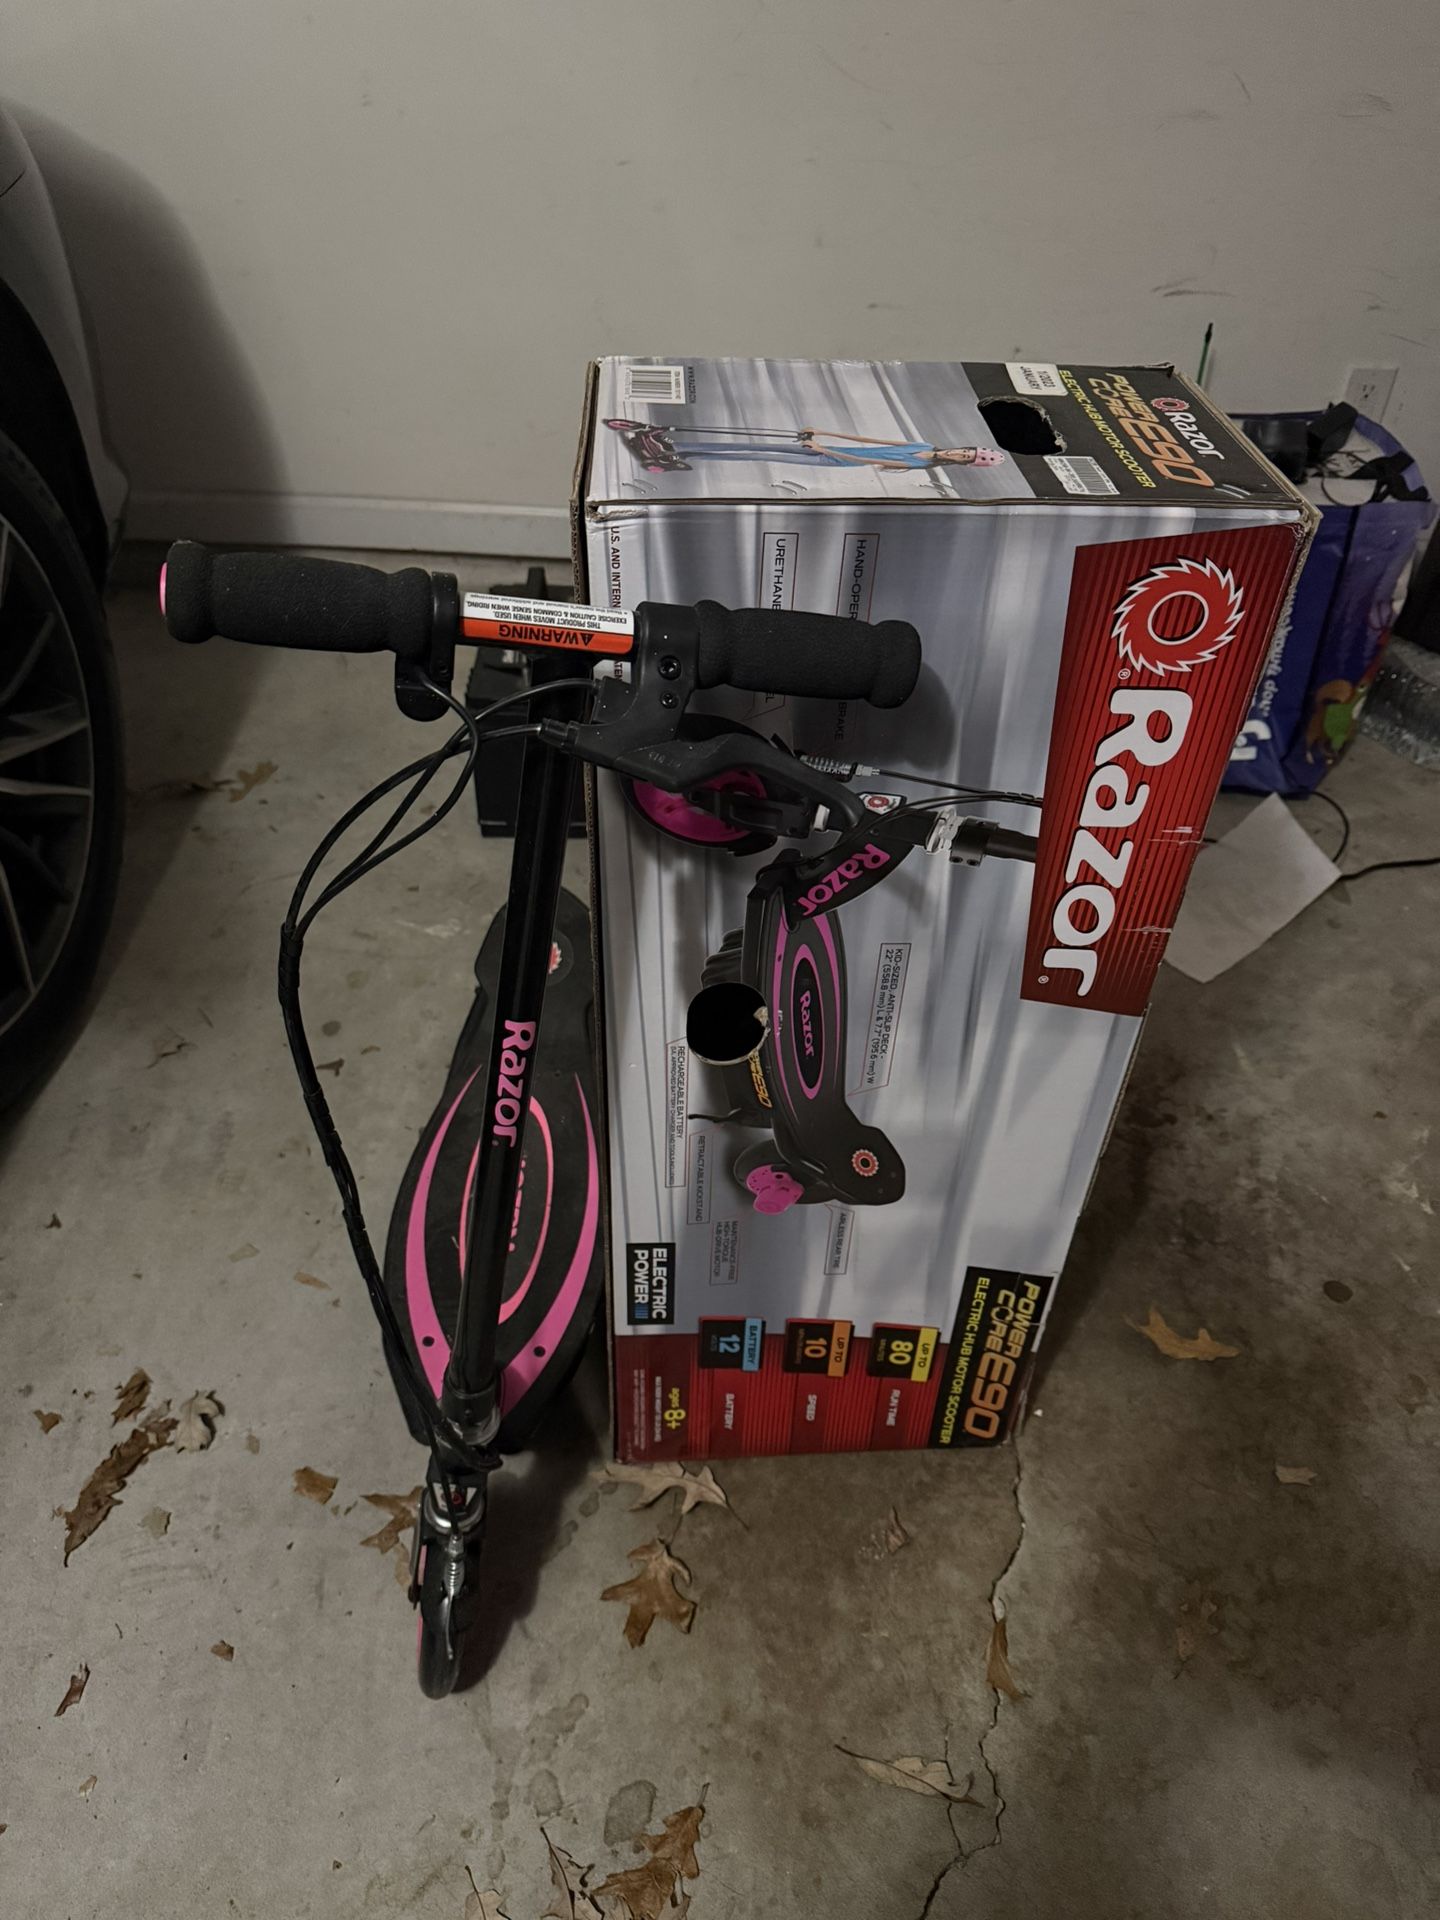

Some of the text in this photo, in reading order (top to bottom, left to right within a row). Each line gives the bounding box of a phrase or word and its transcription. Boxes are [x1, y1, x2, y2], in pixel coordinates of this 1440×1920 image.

[1020, 365, 1042, 390] JANUARY
[1088, 378, 1133, 418] CORE
[1105, 373, 1159, 422] POWER
[1059, 370, 1091, 403] ELECTRIC
[1081, 403, 1103, 419] HUB
[1093, 420, 1124, 448] MOTOR
[1115, 449, 1156, 488] SCOOTER
[1165, 412, 1224, 460] Razor
[1119, 418, 1214, 487] E90
[610, 526, 620, 544] U.S.
[612, 547, 620, 569] AND
[772, 538, 786, 610] URETHANE
[466, 601, 490, 610] RIDING.
[491, 603, 510, 612] WHEN
[493, 611, 511, 619] USED.
[512, 606, 532, 614] SENSE
[513, 613, 532, 622] WHEN
[533, 608, 562, 617] COMMON
[533, 615, 555, 624] MOVES
[557, 617, 586, 628] PRODUCT
[570, 611, 596, 621] CAUTION
[598, 615, 627, 623] EXERCISE
[499, 625, 578, 645] WARNING
[835, 702, 846, 741] BRAKE
[1041, 688, 1195, 997] Razor
[796, 843, 890, 916] Razor
[888, 948, 903, 992] KID-SIZED,
[799, 989, 815, 1057] Razor
[882, 994, 896, 1032] ANTI-SLIP
[879, 1034, 889, 1054] DECK
[493, 1019, 538, 1148] Razor
[677, 1046, 685, 1105] RECHARGEABLE
[695, 1136, 706, 1222] RETRACTABLE KICKSTAND
[838, 1213, 847, 1238] AIRLESS
[728, 1221, 738, 1280] MAINTENANCE-FREE
[835, 1239, 843, 1255] REAR
[633, 1250, 649, 1304] POWER
[652, 1248, 667, 1319] ELECTRIC
[984, 1289, 1015, 1350] CORE
[1005, 1280, 1040, 1357] POWER
[718, 1333, 741, 1353] 12
[747, 1324, 758, 1364] BATTERY
[803, 1337, 827, 1358] 10
[834, 1337, 845, 1363] UP TO
[887, 1340, 913, 1365] 80
[917, 1343, 931, 1368] UP TO
[939, 1277, 990, 1444] ELECTRIC HUB MOTOR SCOOTER
[664, 1387, 686, 1429] ages 8+
[723, 1393, 735, 1429] BATTERY
[805, 1394, 818, 1421] SPEED
[885, 1389, 901, 1427] RUN TIME
[962, 1351, 1016, 1438] E90
